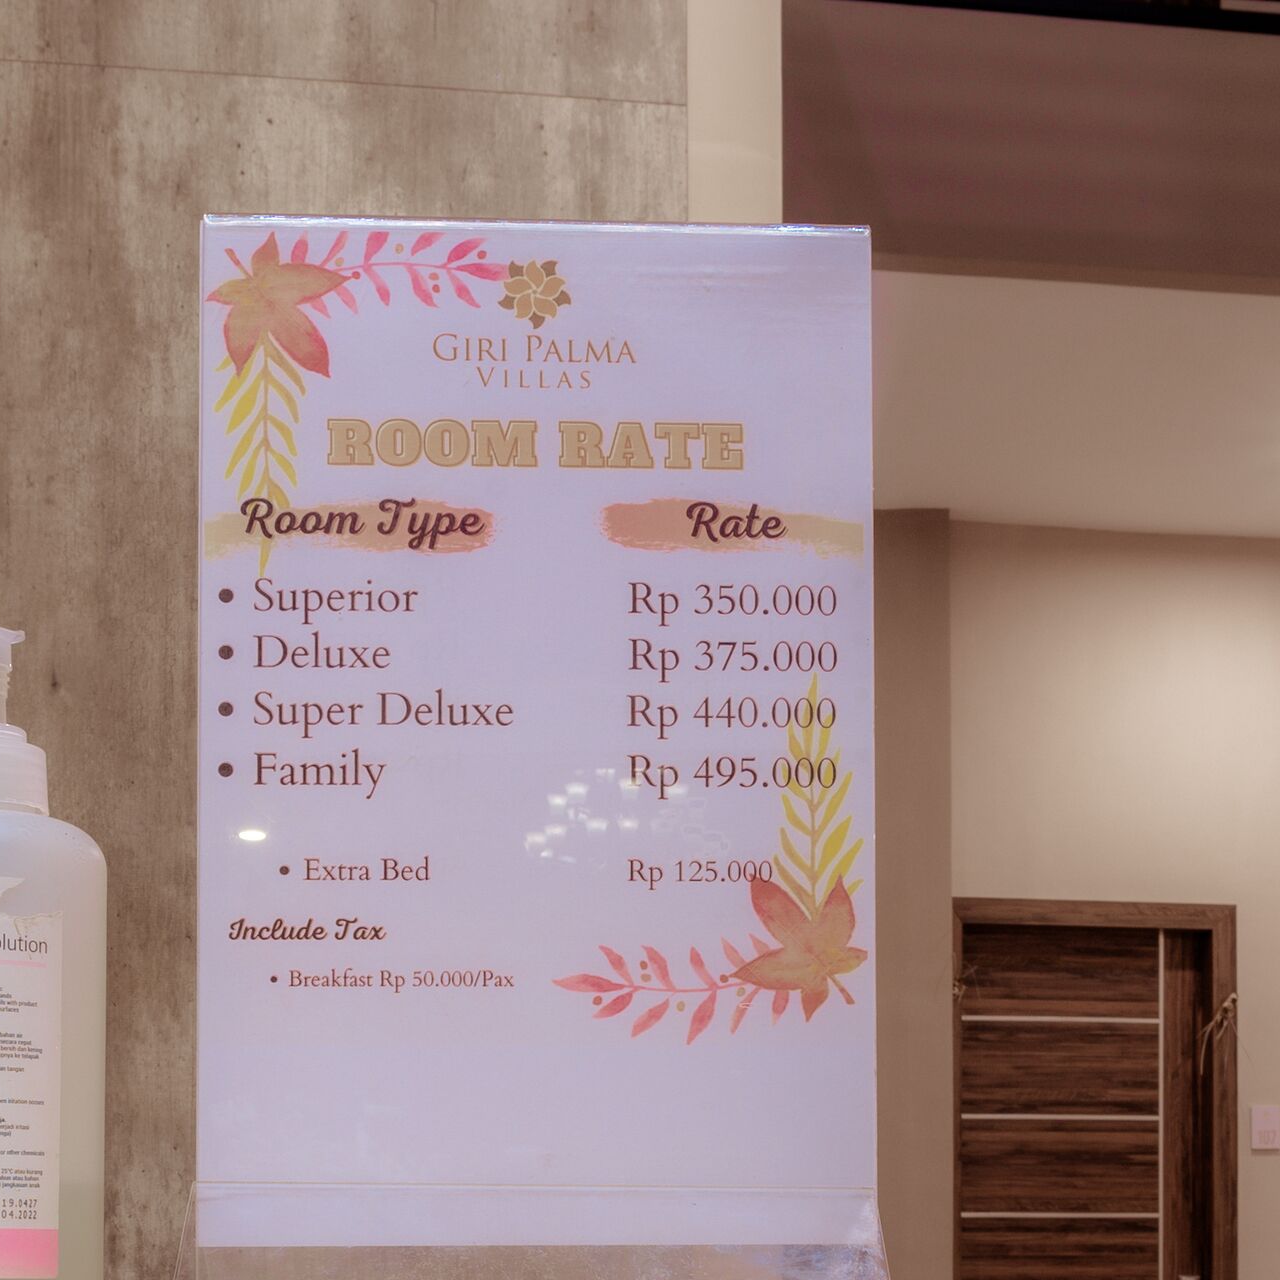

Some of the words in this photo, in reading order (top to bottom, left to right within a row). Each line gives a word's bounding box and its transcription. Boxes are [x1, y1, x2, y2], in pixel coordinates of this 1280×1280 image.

[432, 333, 507, 363] GIRI
[525, 334, 636, 364] PALMA
[477, 367, 592, 389] VILLAS
[327, 418, 537, 468] ROOM
[559, 420, 744, 470] RATE
[241, 498, 364, 539] Room
[378, 498, 485, 550] Type
[686, 502, 787, 539] Rate
[253, 578, 419, 627] Superior
[627, 582, 680, 627] Rp
[693, 583, 838, 617] 350.000
[253, 632, 391, 670] Deluxe
[627, 639, 680, 683] Rp
[693, 639, 838, 673] 375.000
[253, 691, 363, 739] Super
[376, 689, 515, 727] Deluxe
[626, 695, 679, 740] Rp
[692, 695, 838, 730] 440.000
[253, 749, 387, 799] Family
[626, 754, 679, 800] Rp
[693, 755, 838, 789] 495.000
[303, 858, 371, 882] Extra
[381, 857, 430, 882] Bed
[627, 859, 664, 890] Rp
[674, 858, 773, 883] 125.000
[228, 918, 327, 942] Include
[334, 919, 386, 942] Tax
[288, 969, 373, 989] Breakfast
[380, 970, 406, 992] Rp
[412, 969, 514, 989] 50.000/Pax
